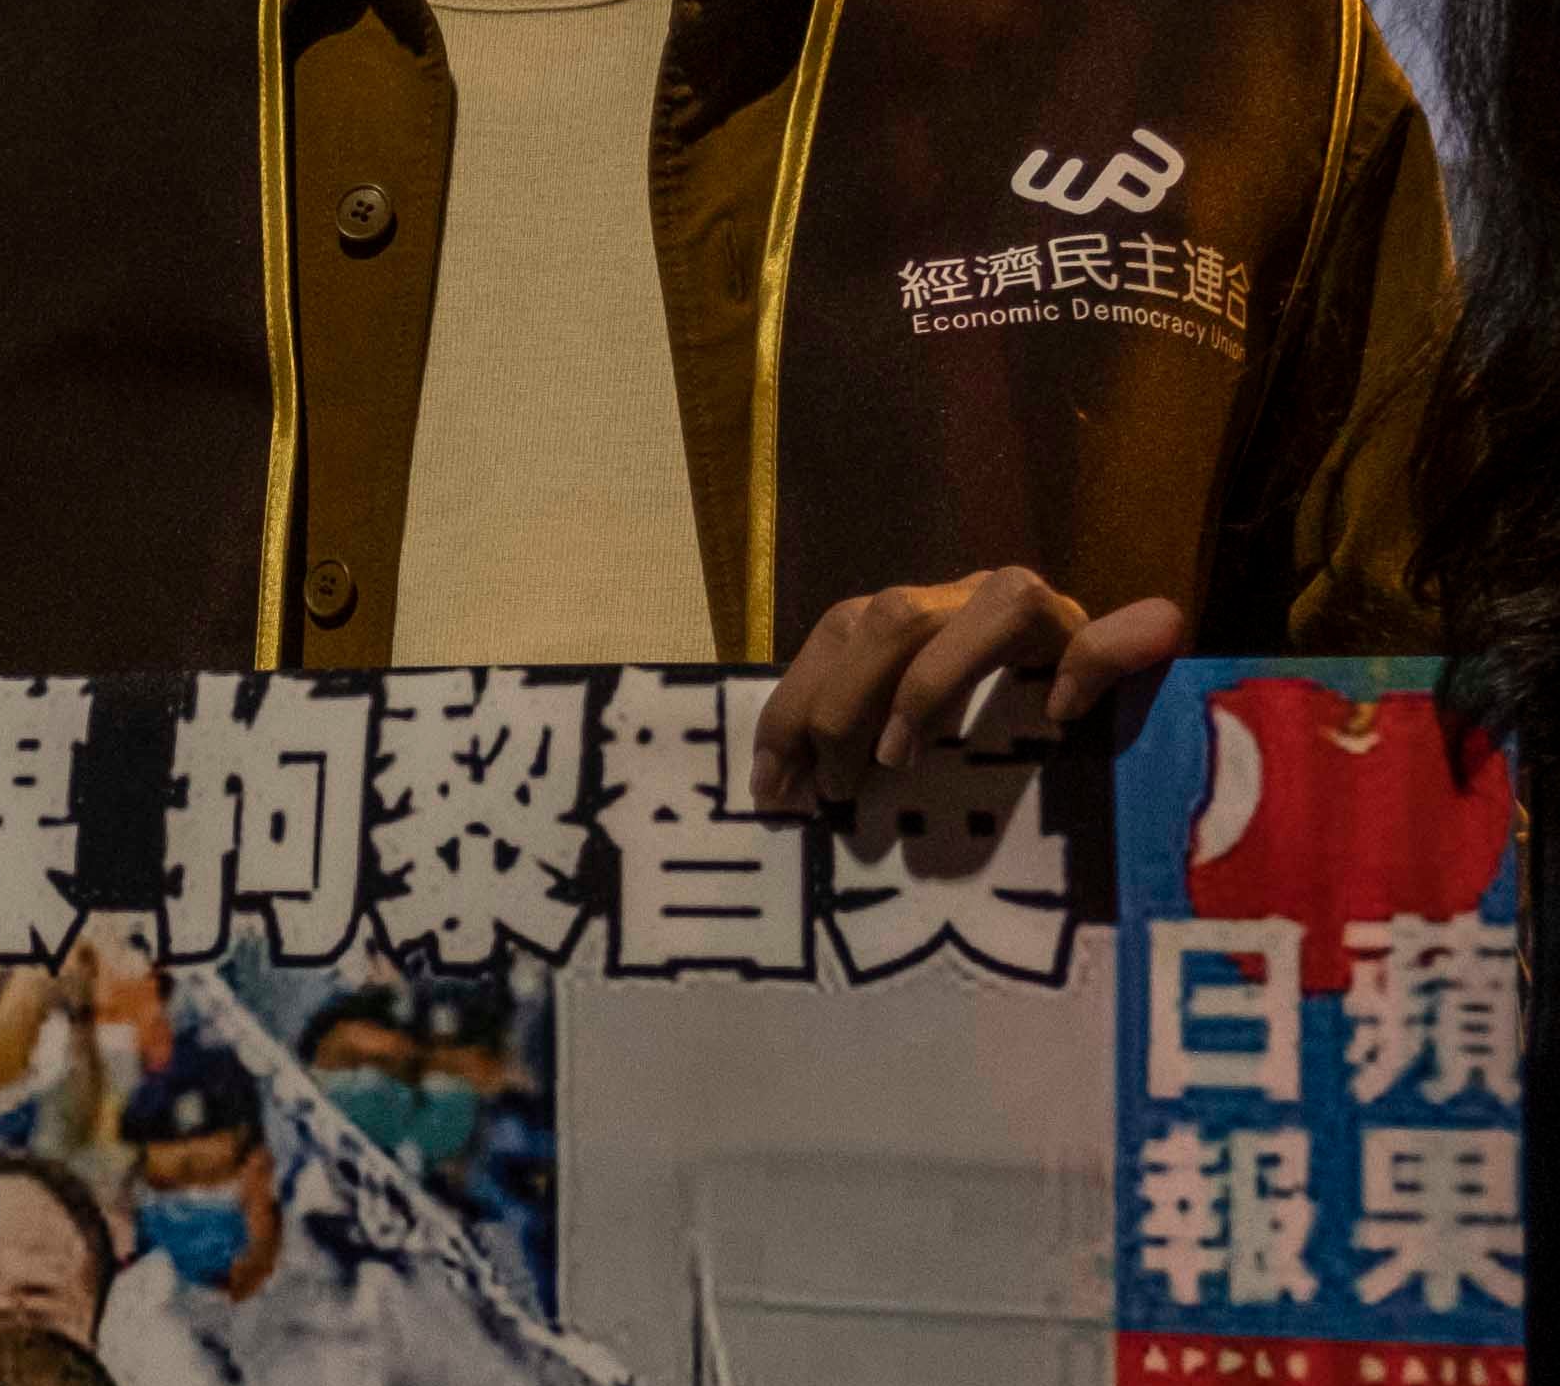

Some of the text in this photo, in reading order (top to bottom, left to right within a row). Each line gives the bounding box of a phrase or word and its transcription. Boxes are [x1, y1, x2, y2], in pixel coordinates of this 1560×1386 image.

[897, 232, 1251, 331] 經濟民主連合
[911, 298, 1247, 363] Economic Democracy Union
[1137, 913, 1320, 1308] 日報
[1340, 909, 1523, 1313] 蘋果
[1142, 1342, 1310, 1381] APPLE
